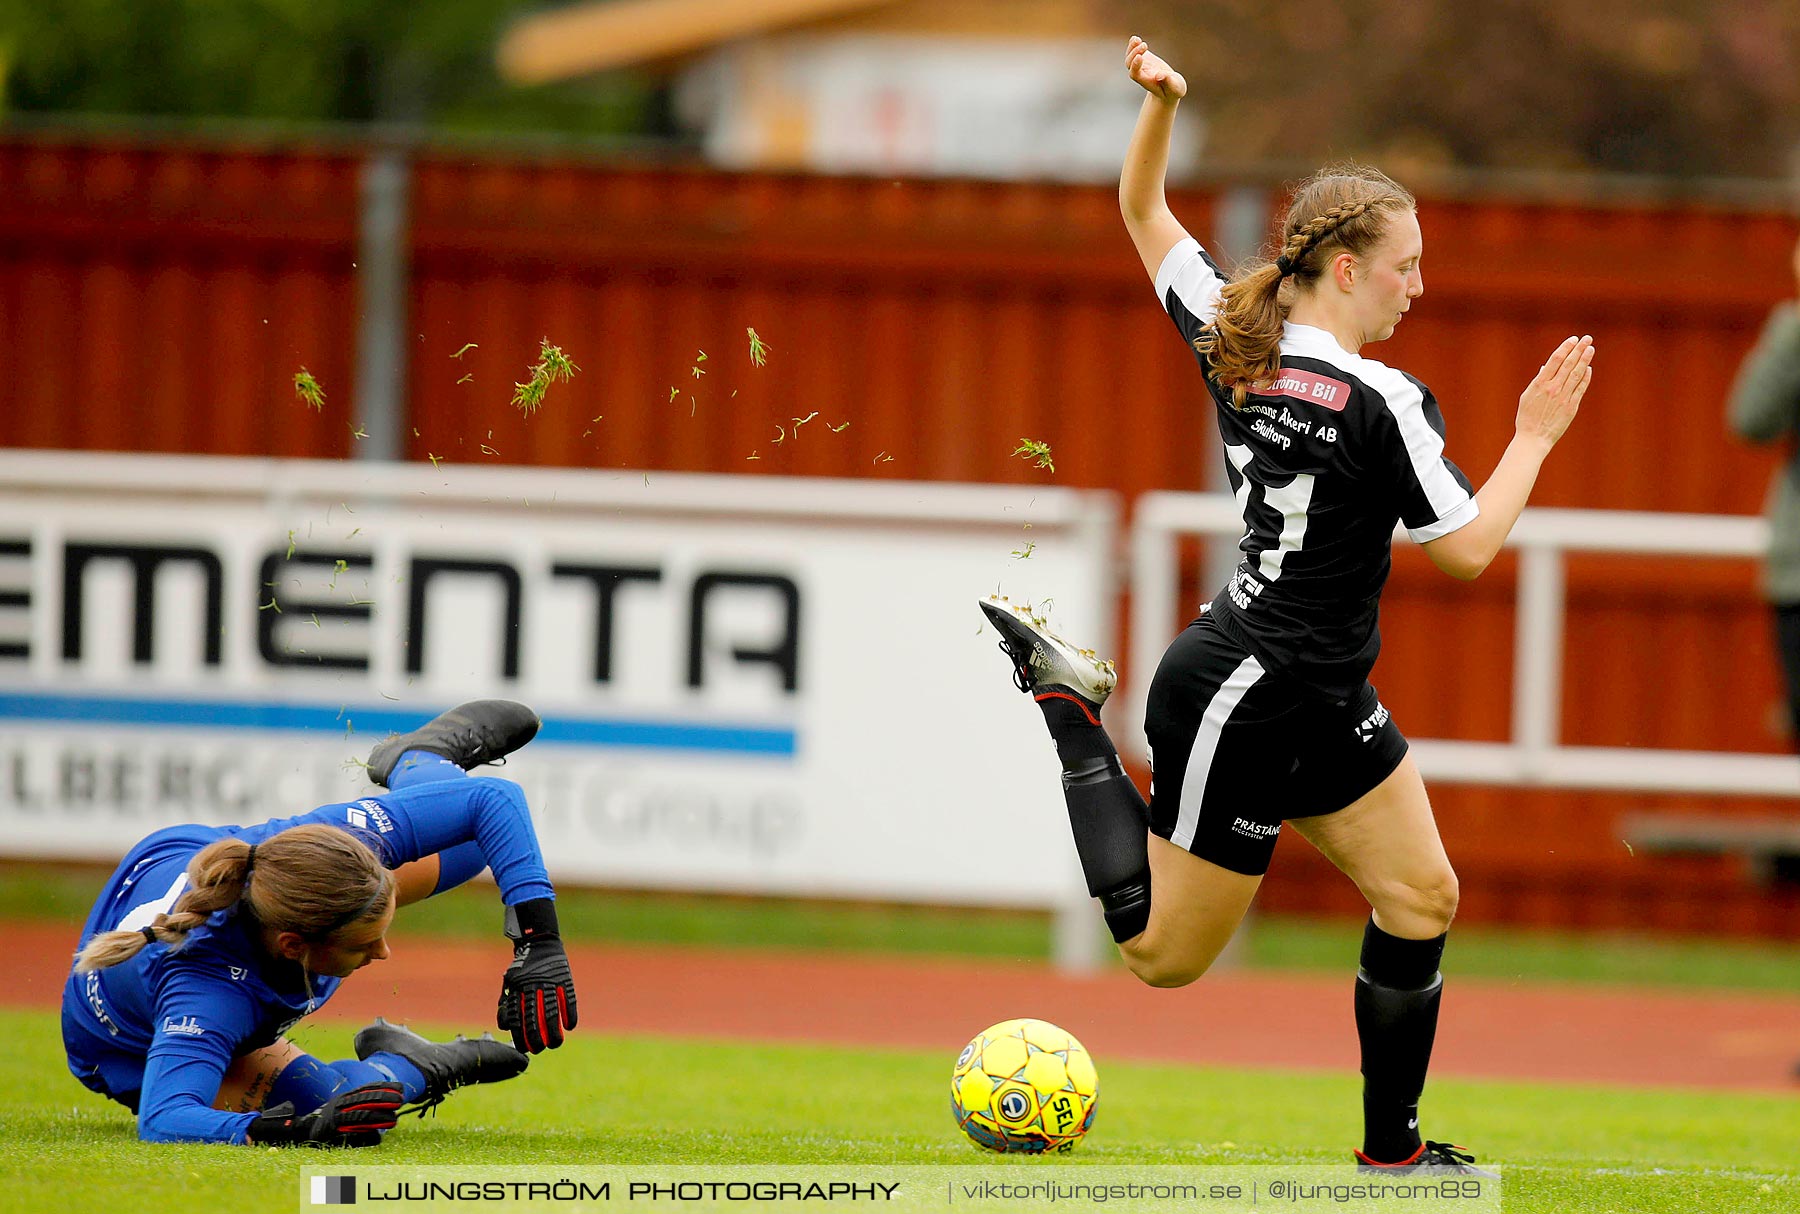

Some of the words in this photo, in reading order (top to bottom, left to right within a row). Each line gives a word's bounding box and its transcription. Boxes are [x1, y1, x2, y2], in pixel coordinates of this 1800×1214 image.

[1311, 381, 1338, 402] Bil
[1250, 418, 1291, 451] Skultorp
[1278, 407, 1312, 435] Åkeri
[1315, 425, 1338, 443] AB
[0, 540, 801, 693] MENTA
